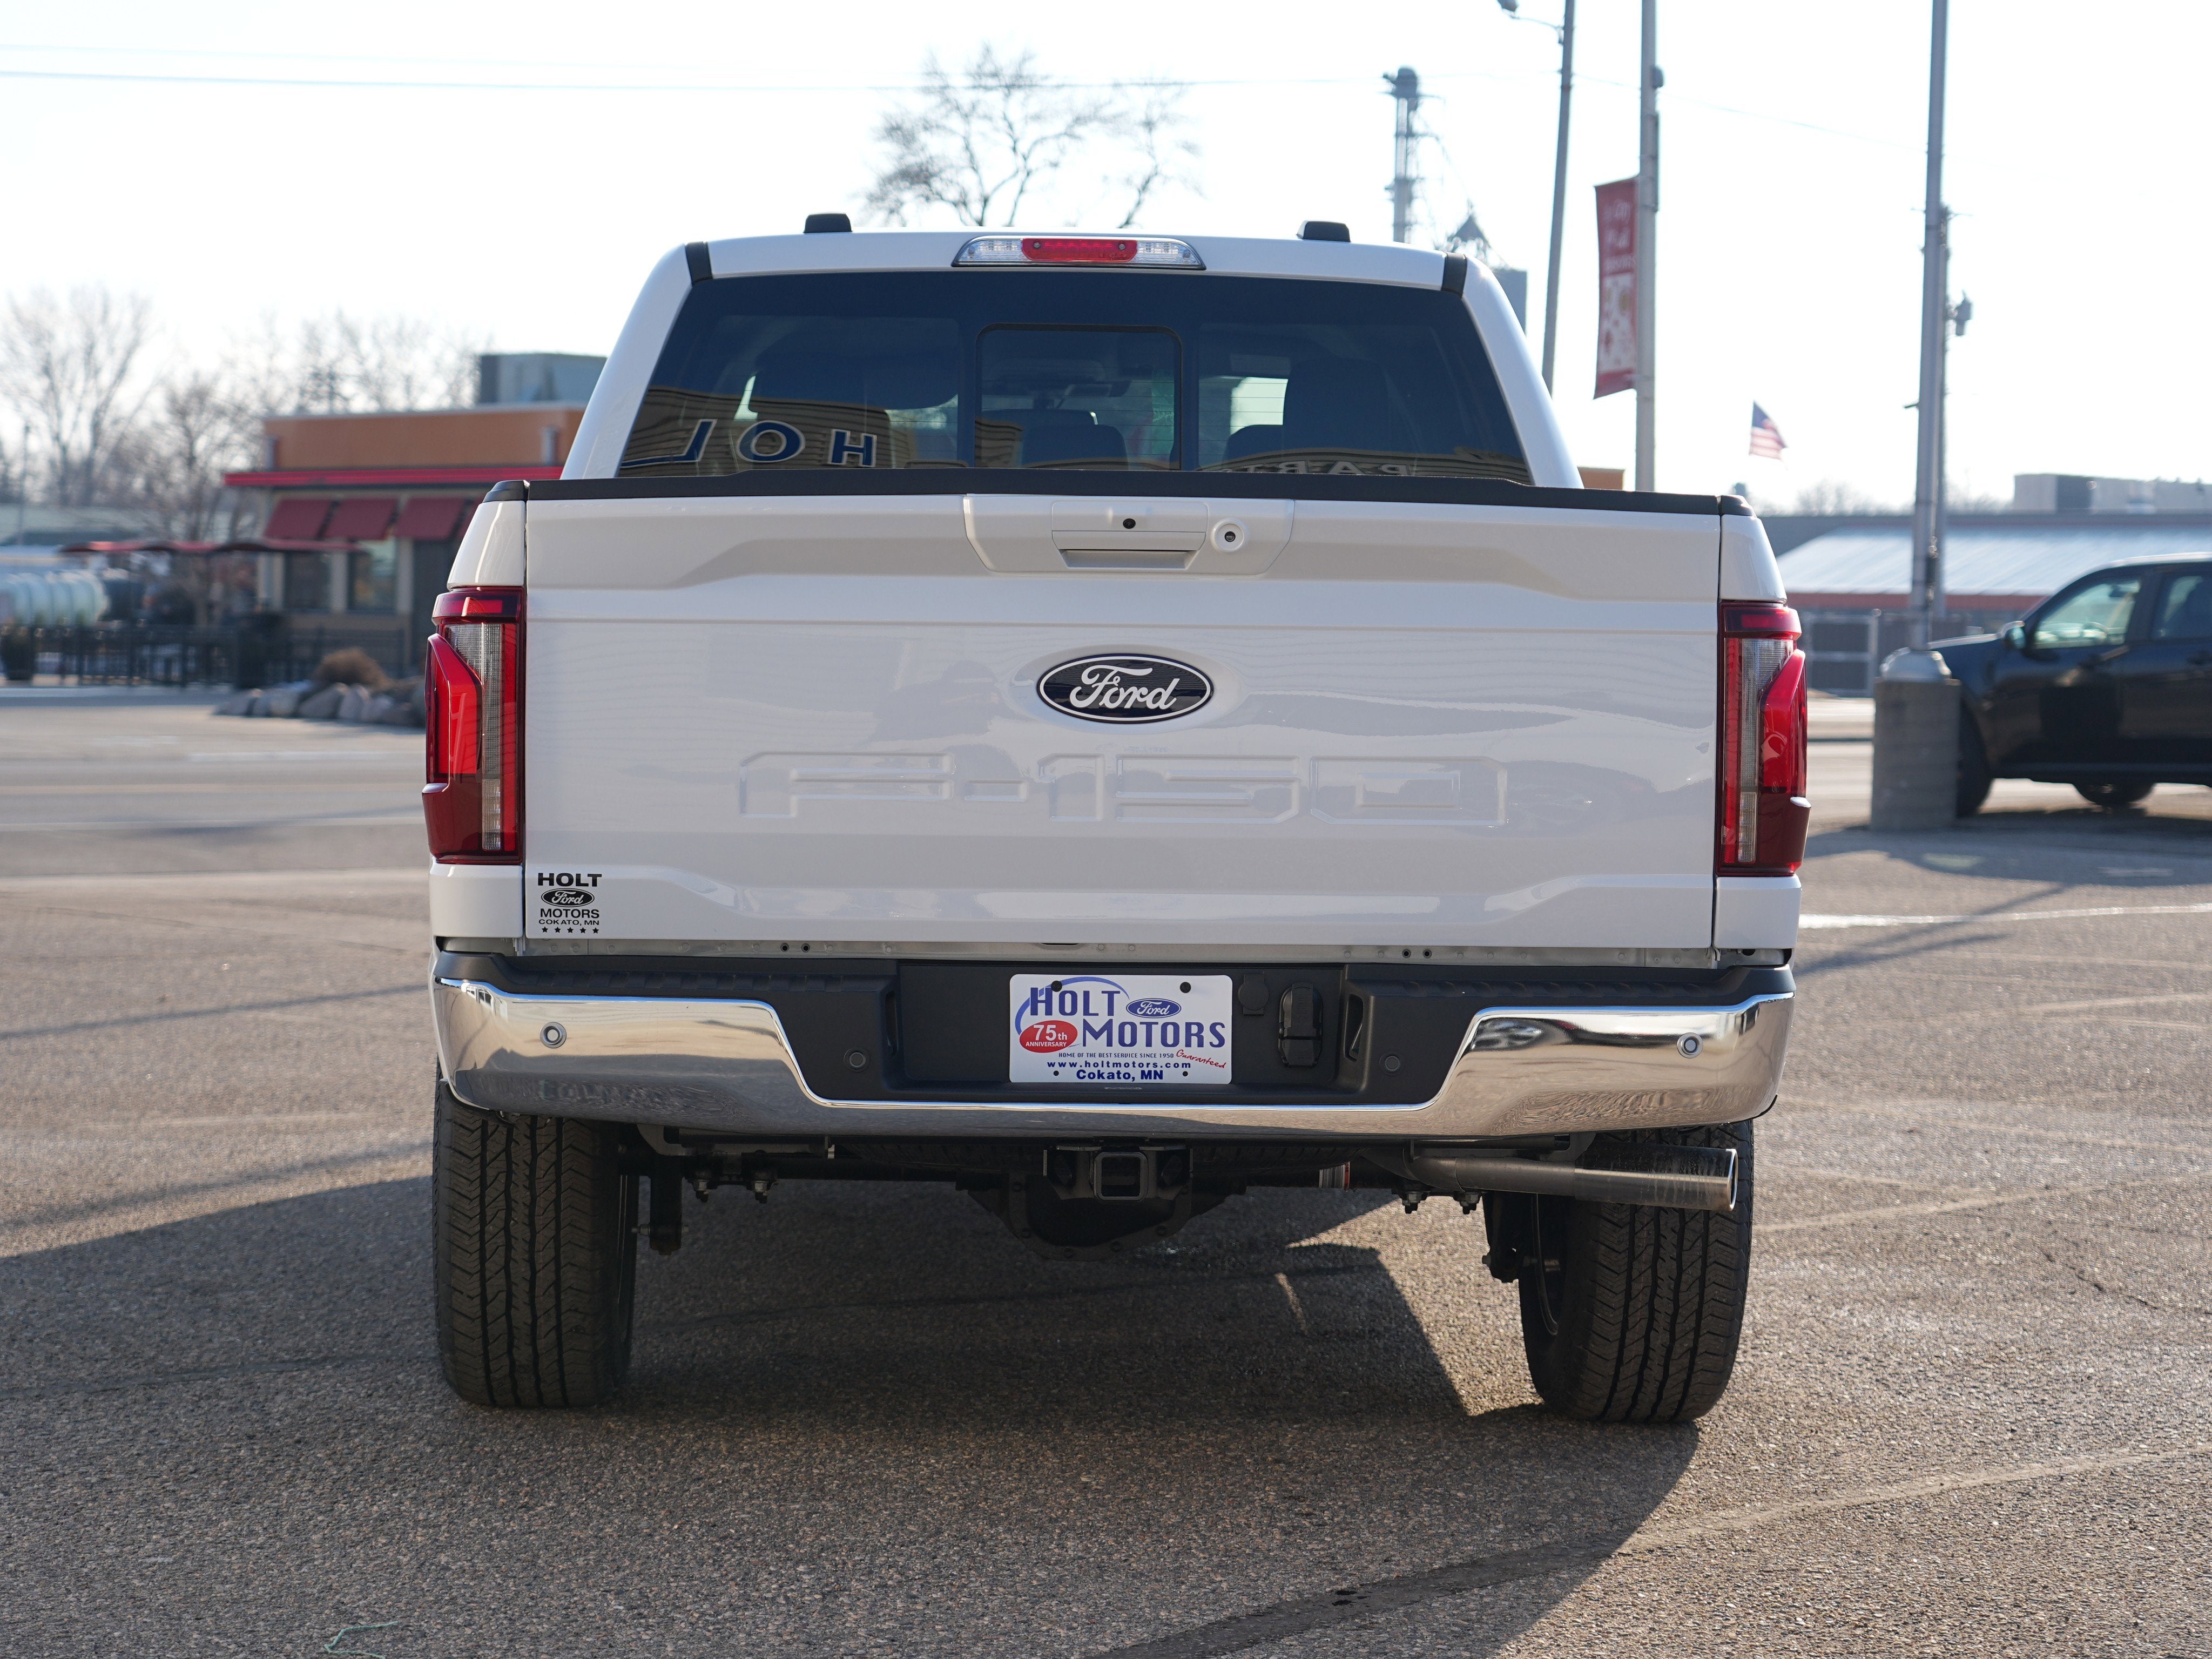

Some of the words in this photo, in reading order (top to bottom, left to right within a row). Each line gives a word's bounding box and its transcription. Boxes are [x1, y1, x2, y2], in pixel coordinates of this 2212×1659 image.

[1070, 665, 1181, 710] Ford
[739, 751, 1508, 826] F-150
[538, 873, 602, 887] HOLT
[551, 891, 584, 905] Ford
[540, 908, 599, 919] MOTORS
[1030, 987, 1121, 1016] HOLT
[1137, 1002, 1170, 1015] Ford
[1033, 1024, 1068, 1041] 75th
[1083, 1019, 1225, 1048] MOTORS
[1176, 1049, 1226, 1069] Guaranteed
[1076, 1069, 1135, 1082] Cokato,
[1141, 1070, 1163, 1080] MN
